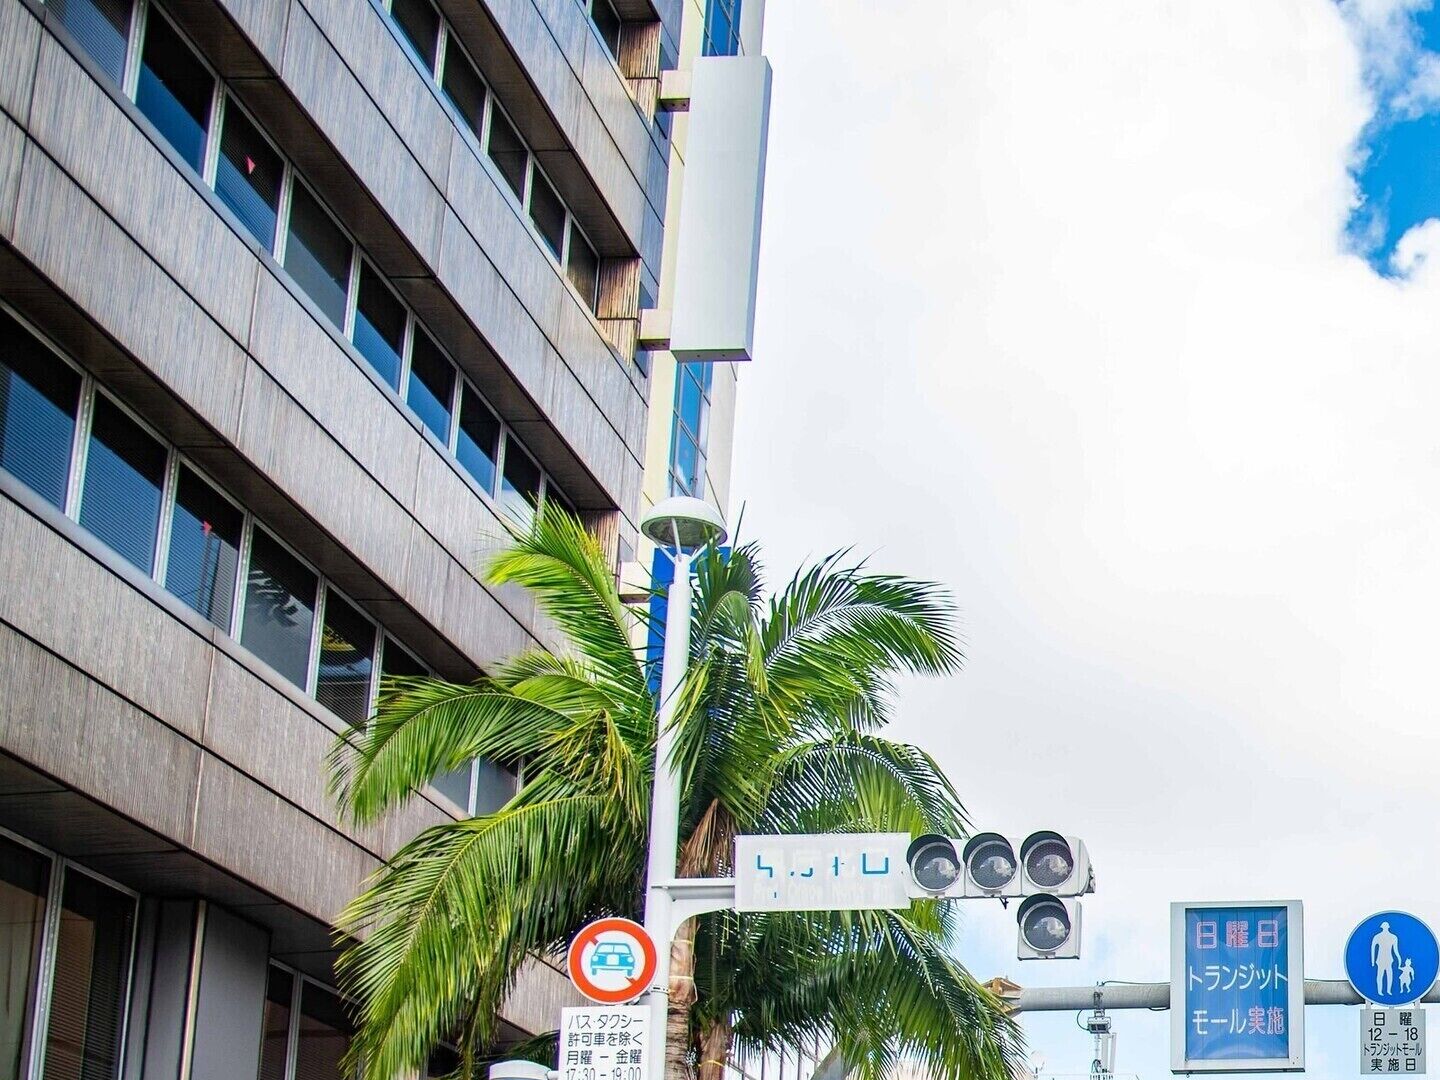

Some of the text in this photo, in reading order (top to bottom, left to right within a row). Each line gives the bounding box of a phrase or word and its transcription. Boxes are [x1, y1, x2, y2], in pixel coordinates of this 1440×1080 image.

[1196, 919, 1279, 949] 日曜日
[1189, 963, 1288, 991] トランジット
[568, 1014, 644, 1030] バス・タクシー
[1192, 1006, 1285, 1035] モール実施
[1373, 1011, 1412, 1026] 日曜
[568, 1032, 643, 1047] 許可車を除く
[1367, 1027, 1382, 1041] 12
[1404, 1027, 1419, 1041] 18
[1363, 1043, 1423, 1057] トランジットモール
[1370, 1058, 1417, 1072] 実施日
